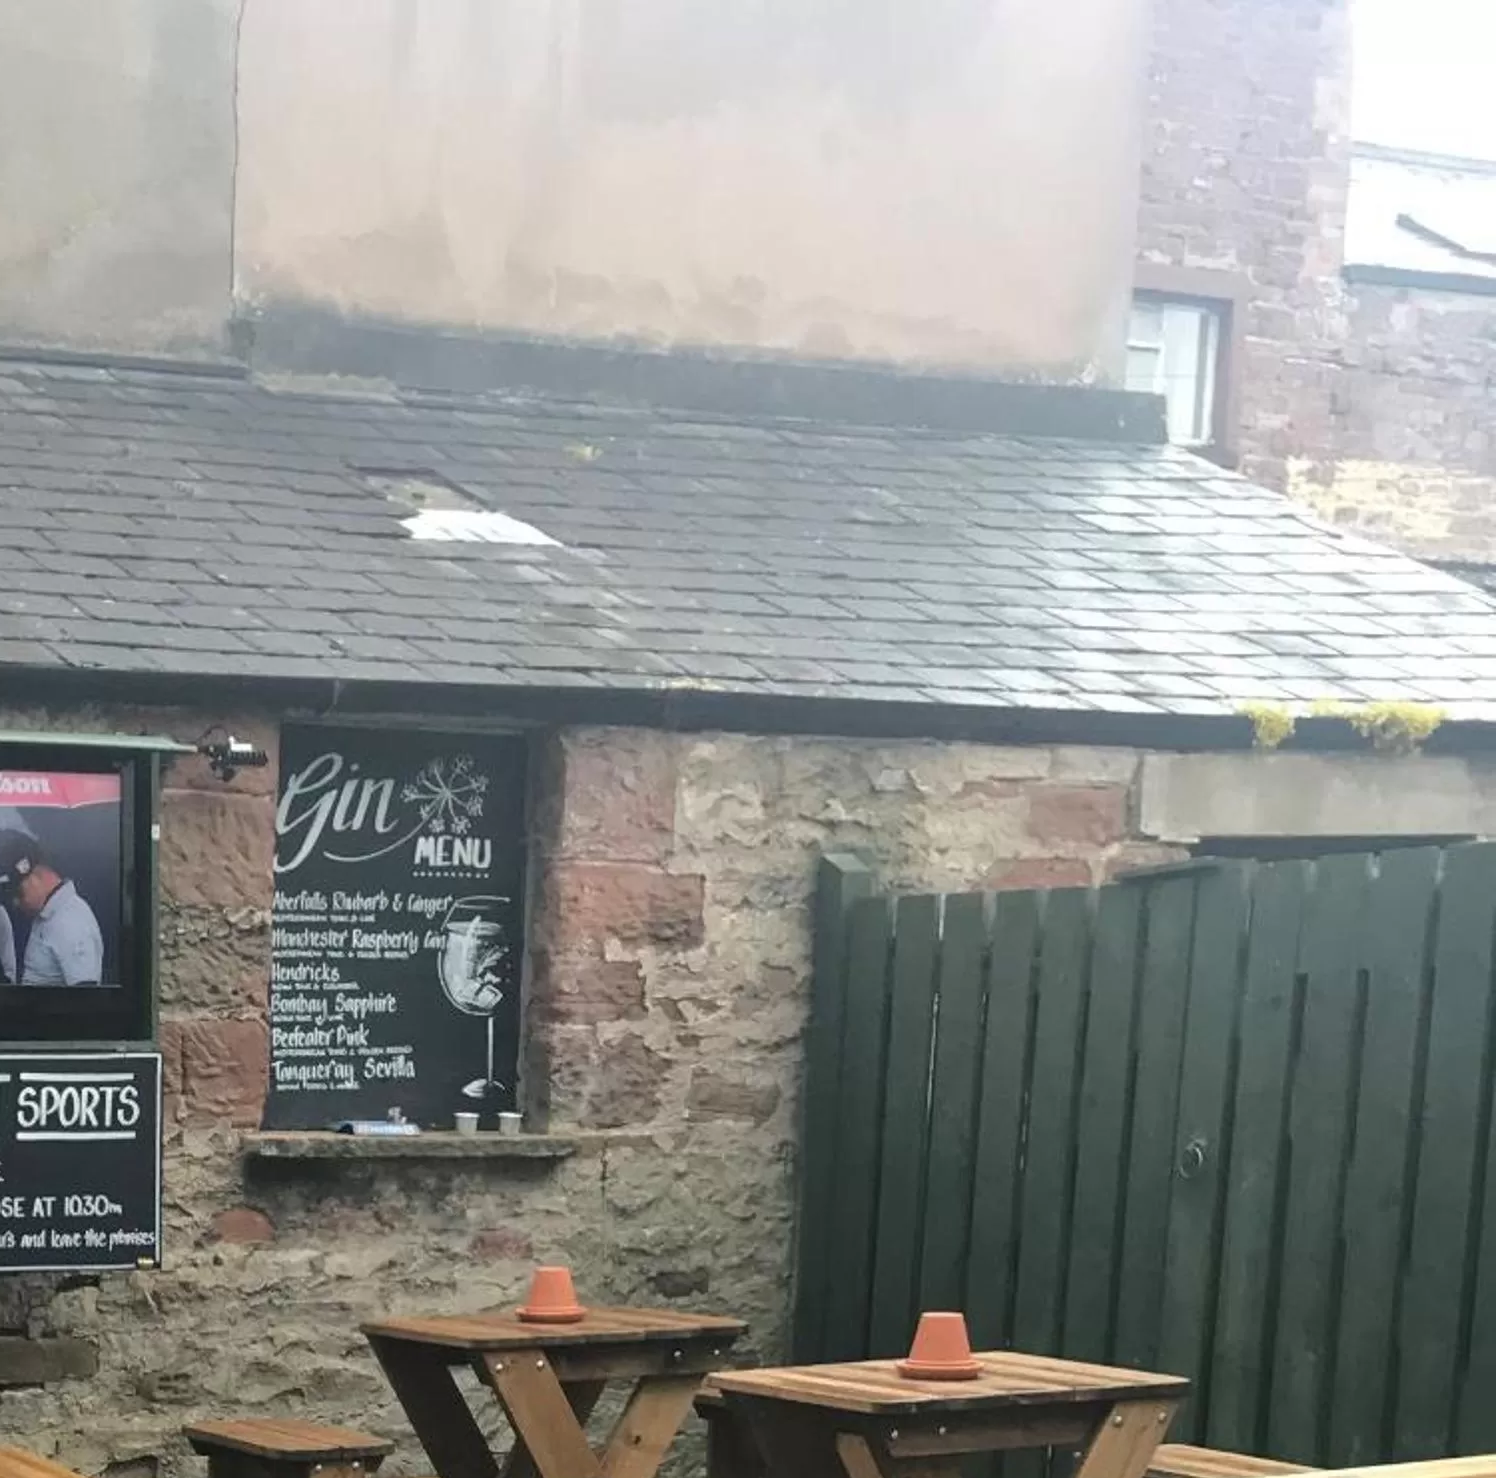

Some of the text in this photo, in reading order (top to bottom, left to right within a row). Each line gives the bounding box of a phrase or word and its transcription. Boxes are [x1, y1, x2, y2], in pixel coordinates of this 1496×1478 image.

[273, 752, 492, 873] Gin MENU
[333, 889, 388, 911] Rhubarb
[393, 893, 403, 912] &
[408, 893, 453, 920] Ginger
[272, 928, 348, 949] Manchester
[352, 928, 419, 955] Raspberry
[272, 962, 340, 982] Hendricks
[271, 992, 397, 1022] Bombay Sapphire
[272, 1024, 370, 1048] Beefeater Pink
[272, 1055, 415, 1088] Tanqueray Sevilla
[17, 1085, 141, 1128] SPORTS
[32, 1197, 56, 1217] AT
[21, 1230, 46, 1248] and
[51, 1229, 81, 1248] leave
[83, 1228, 106, 1248] the
[109, 1228, 156, 1251] premises
